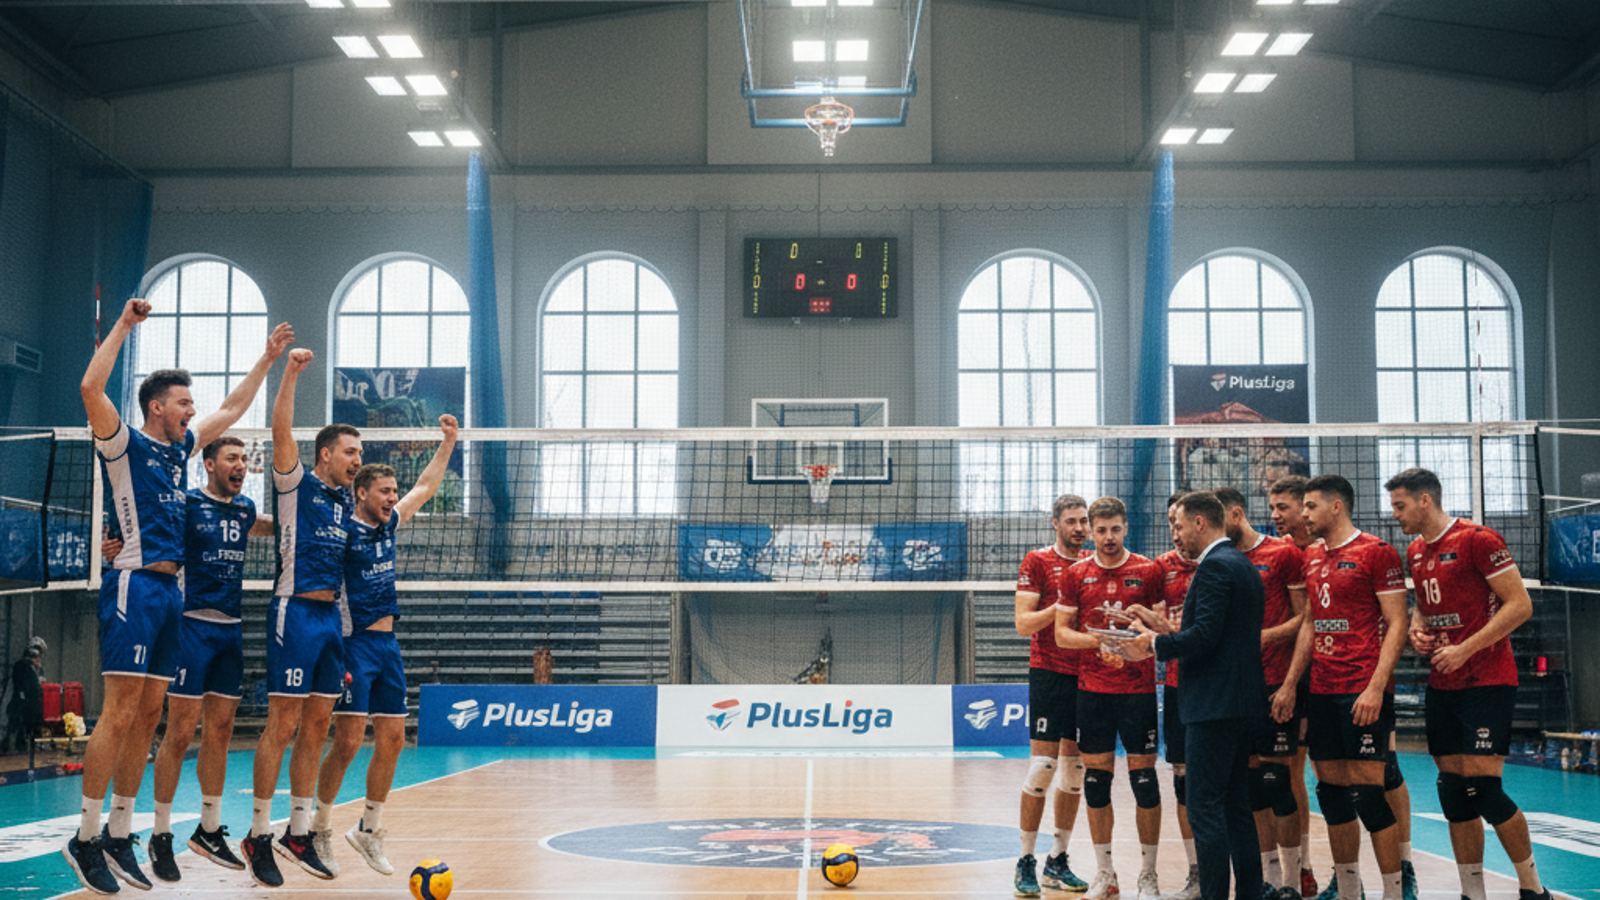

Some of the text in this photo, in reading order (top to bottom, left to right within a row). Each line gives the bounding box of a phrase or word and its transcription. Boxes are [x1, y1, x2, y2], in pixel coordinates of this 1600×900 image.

[285, 668, 304, 687] 18
[482, 700, 613, 733] PlusLiga
[746, 699, 893, 734] PlusLiga
